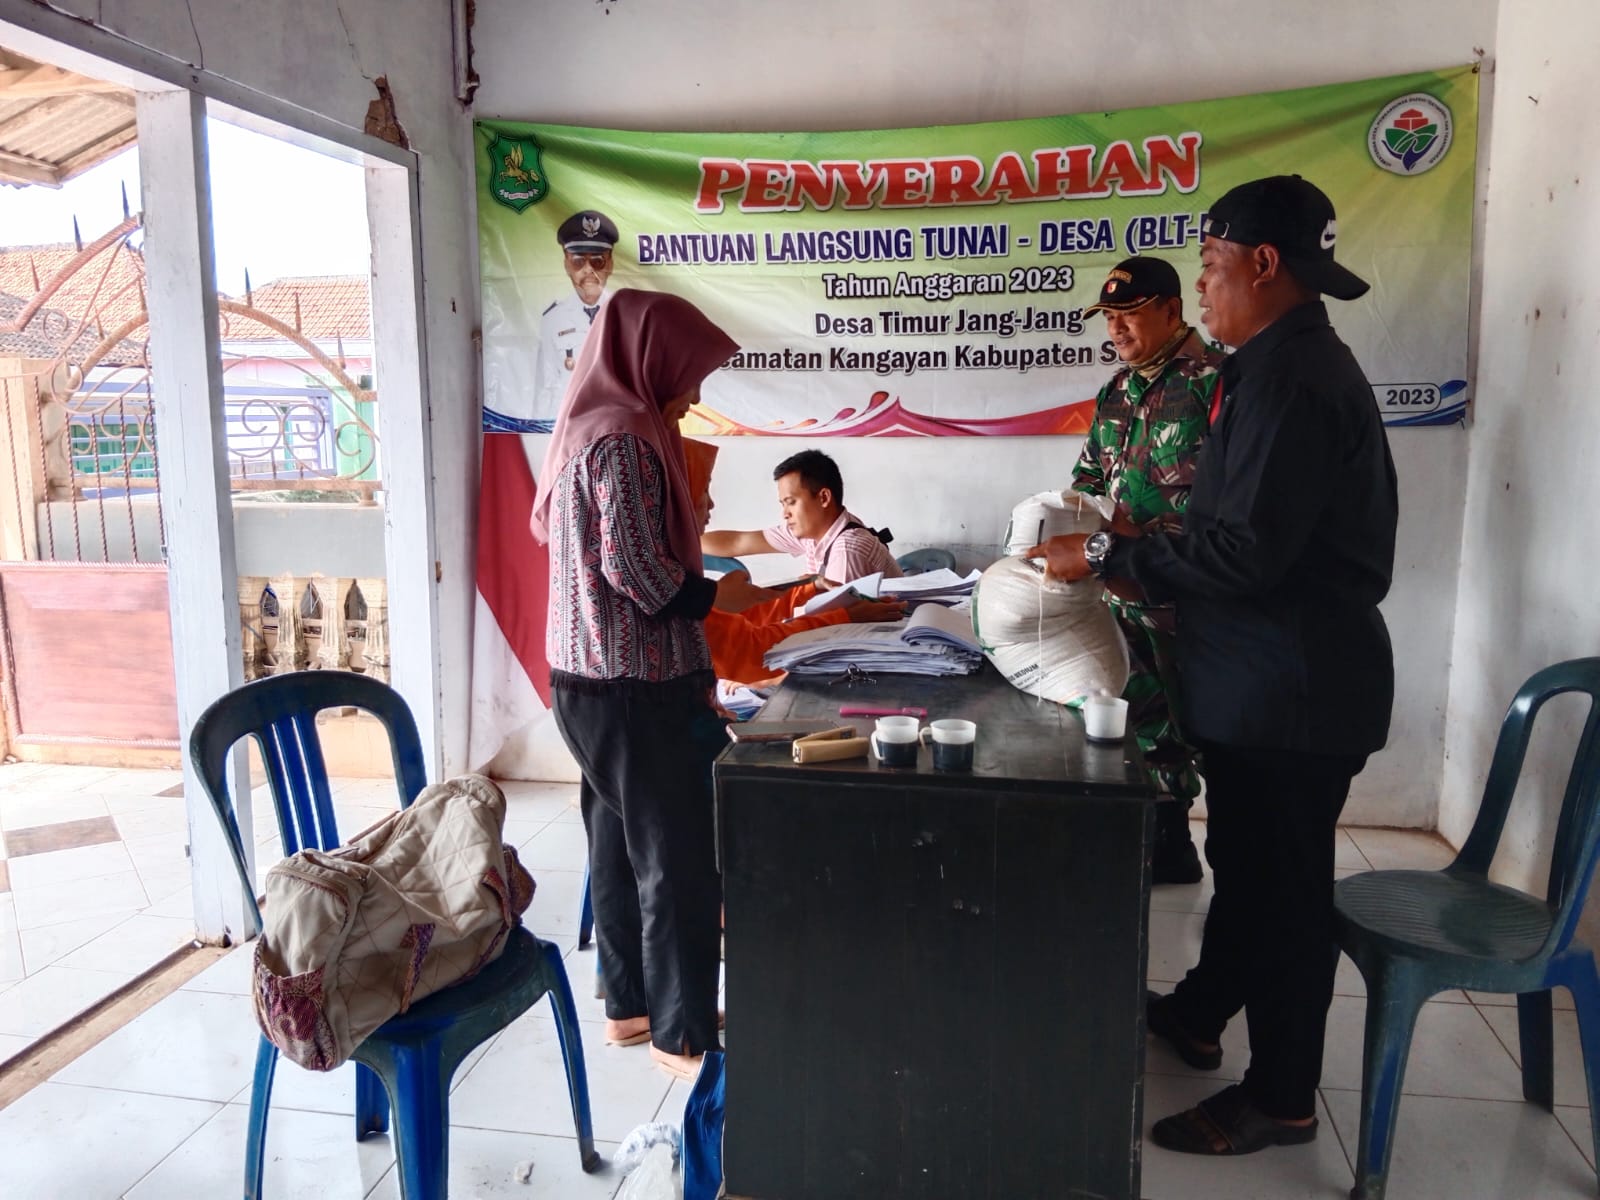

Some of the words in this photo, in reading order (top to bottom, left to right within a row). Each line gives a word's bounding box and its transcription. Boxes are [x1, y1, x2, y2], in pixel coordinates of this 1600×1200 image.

[695, 134, 1201, 211] PENYERAHAN
[638, 233, 755, 264] BANTUAN
[765, 229, 912, 262] LANGSUNG
[921, 224, 1008, 258] TUNAI
[1040, 220, 1114, 252] DESA
[823, 273, 889, 298] Tahun
[894, 271, 1004, 300] Anggaran
[1010, 266, 1073, 291] 2023
[816, 312, 873, 335] Desa
[880, 311, 950, 335] Timur
[955, 307, 1084, 336] Jang-Jang
[830, 346, 947, 372] Kangayan
[955, 343, 1092, 372] Kabupaten
[1386, 388, 1435, 406] 2023
